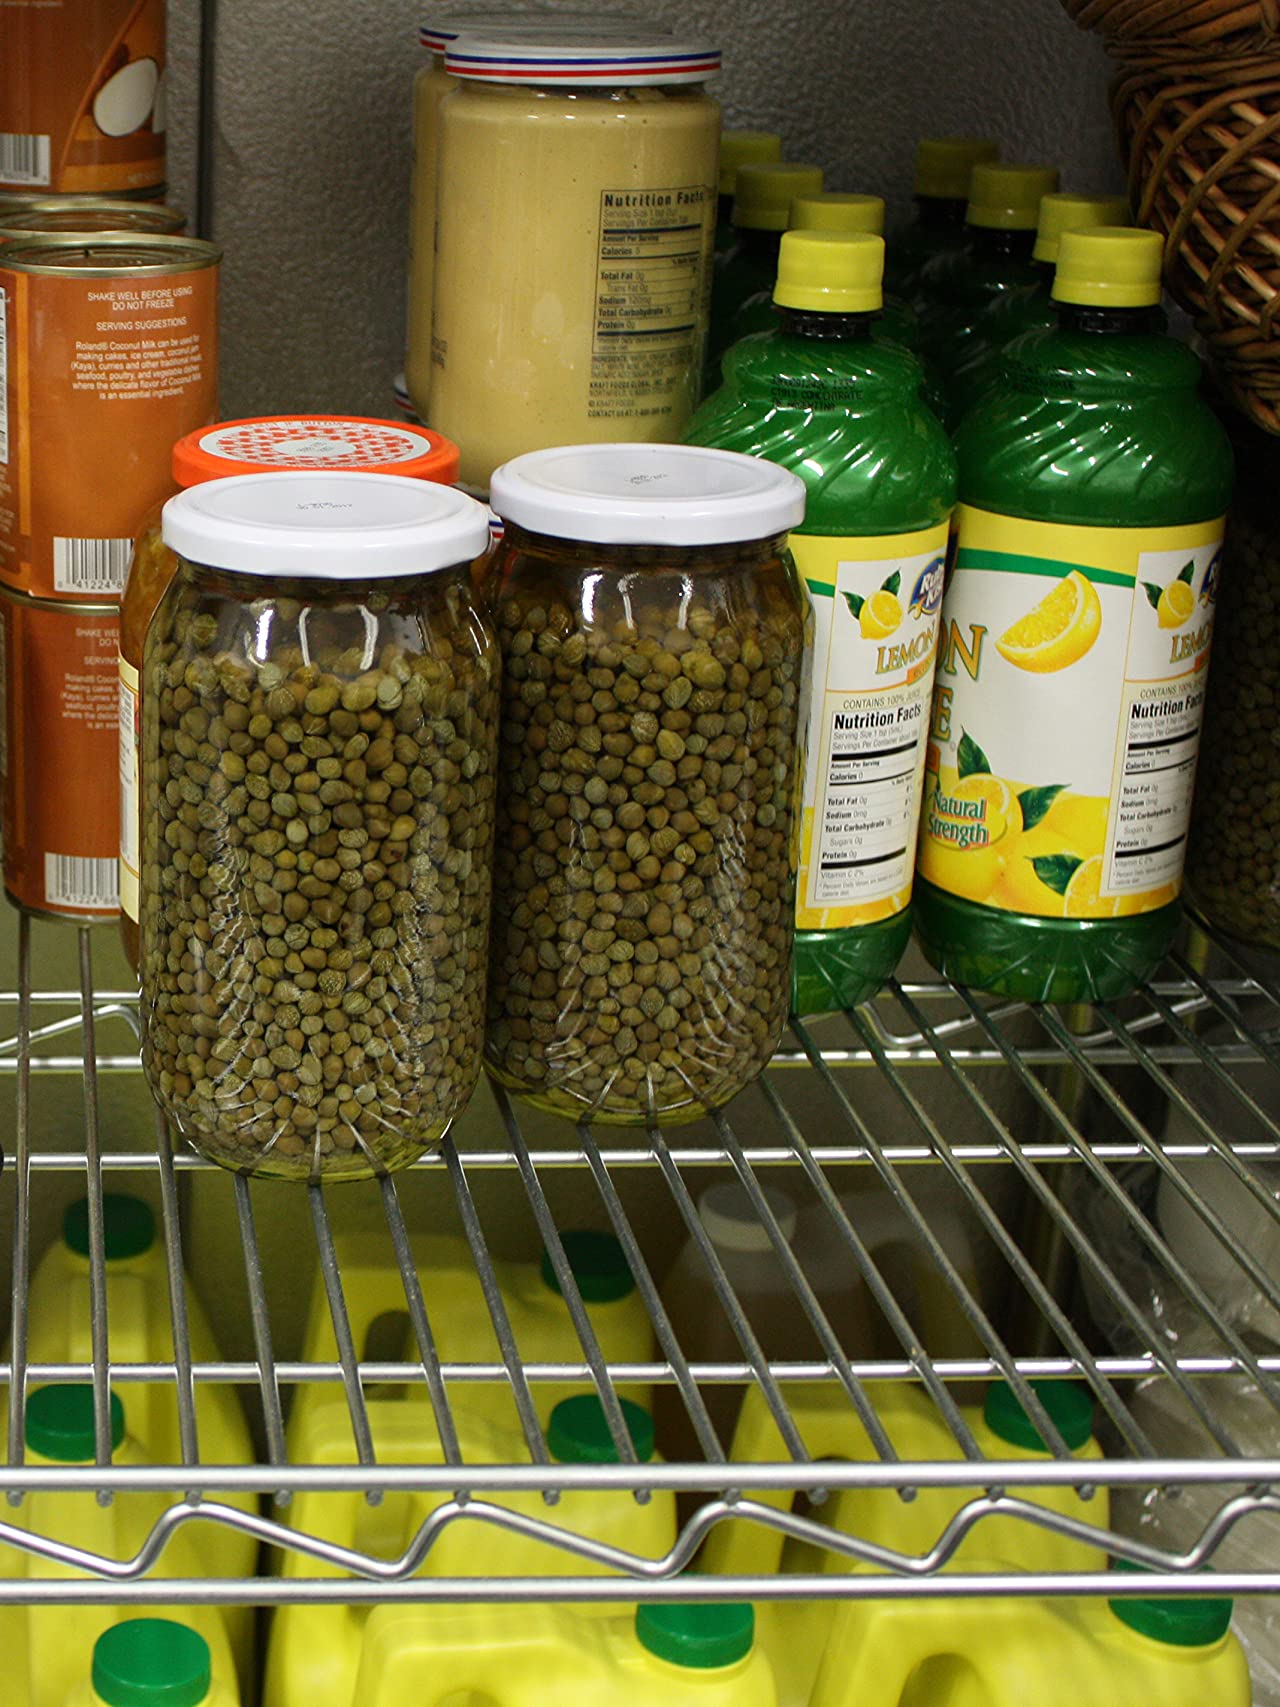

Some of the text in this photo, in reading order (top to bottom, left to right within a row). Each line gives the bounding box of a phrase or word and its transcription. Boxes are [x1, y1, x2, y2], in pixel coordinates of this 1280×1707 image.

[604, 194, 672, 207] Nutrition
[601, 247, 633, 256] Calories
[600, 272, 619, 280] Total
[88, 286, 192, 301] SHAKE WELL BEFORE USING
[112, 298, 174, 311] DO NOT FREEZE
[599, 297, 626, 305] Sodium
[599, 308, 617, 317] Total
[96, 316, 187, 331] SERVING SUGGESTIONS
[598, 321, 624, 329] Protein
[875, 619, 936, 675] LEMON
[1140, 686, 1176, 699] CONTAINS
[843, 697, 885, 710] CONTAINS
[1131, 700, 1184, 719] Nutrition
[834, 703, 922, 730] Nutrition Facts
[833, 731, 858, 741] Serving
[860, 730, 873, 738] Size
[832, 741, 861, 751] Servings
[862, 740, 873, 749] Per
[862, 760, 880, 769] Serving
[1125, 761, 1150, 771] Calories
[830, 772, 858, 781] Calories
[1123, 786, 1138, 795] Total
[1140, 785, 1150, 793] Fat
[828, 798, 845, 806] Total
[846, 797, 858, 805] Fat
[933, 790, 988, 821] Natural
[1121, 800, 1144, 809] Sodium
[826, 811, 852, 819] Sodium
[1120, 814, 1136, 822] Total
[825, 820, 885, 833] Total Carbohydrate
[928, 813, 989, 849] Strength
[830, 838, 853, 848] Sugars
[1116, 840, 1139, 849] Protein
[822, 851, 848, 860] Protein
[820, 871, 847, 880] Vitamin
